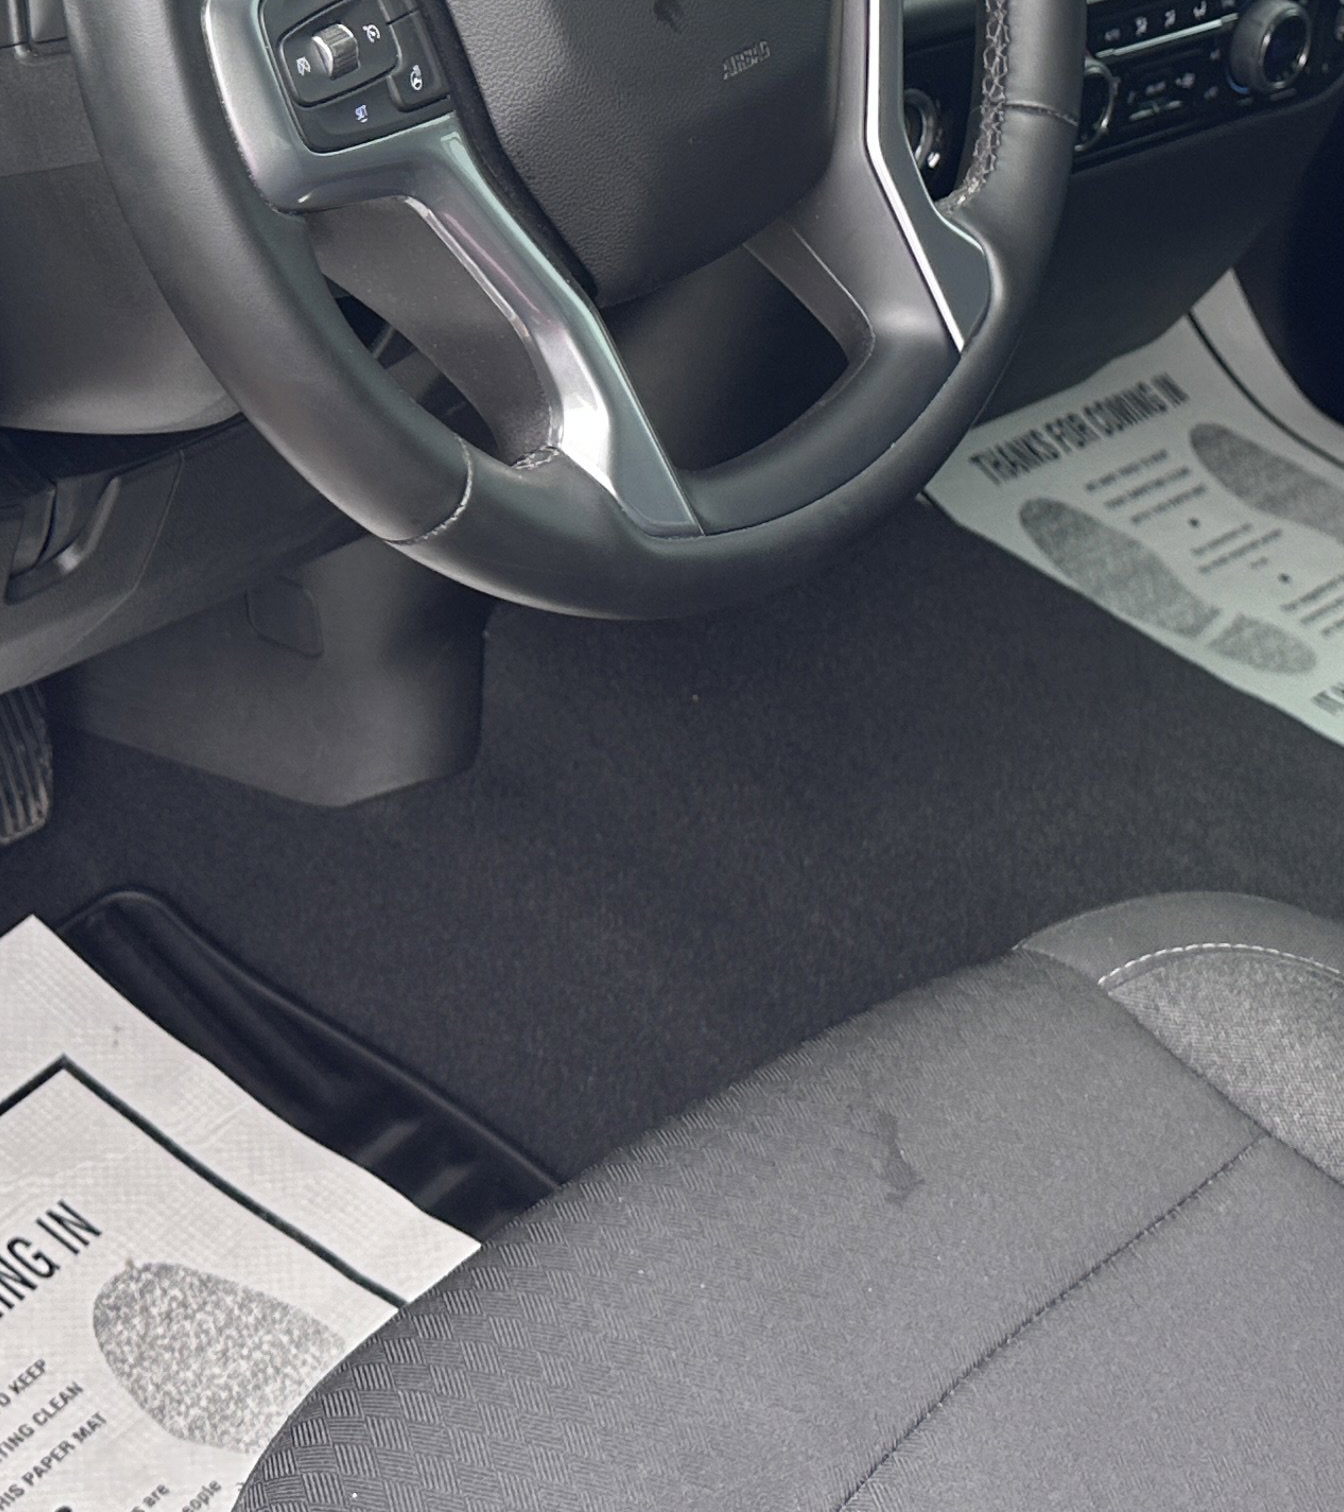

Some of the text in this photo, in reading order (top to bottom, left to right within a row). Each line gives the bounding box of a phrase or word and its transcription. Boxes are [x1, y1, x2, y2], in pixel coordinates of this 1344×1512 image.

[968, 429, 1061, 487] THANKS
[1045, 411, 1101, 455] FOR
[1082, 381, 1168, 437] COMING
[1151, 372, 1191, 408] IN
[36, 1199, 104, 1256] IN
[8, 1358, 46, 1396] KEEP
[32, 1381, 84, 1427] CLEAN
[21, 1439, 76, 1487] PAPER
[72, 1411, 108, 1444] MAT
[142, 1483, 171, 1508] are
